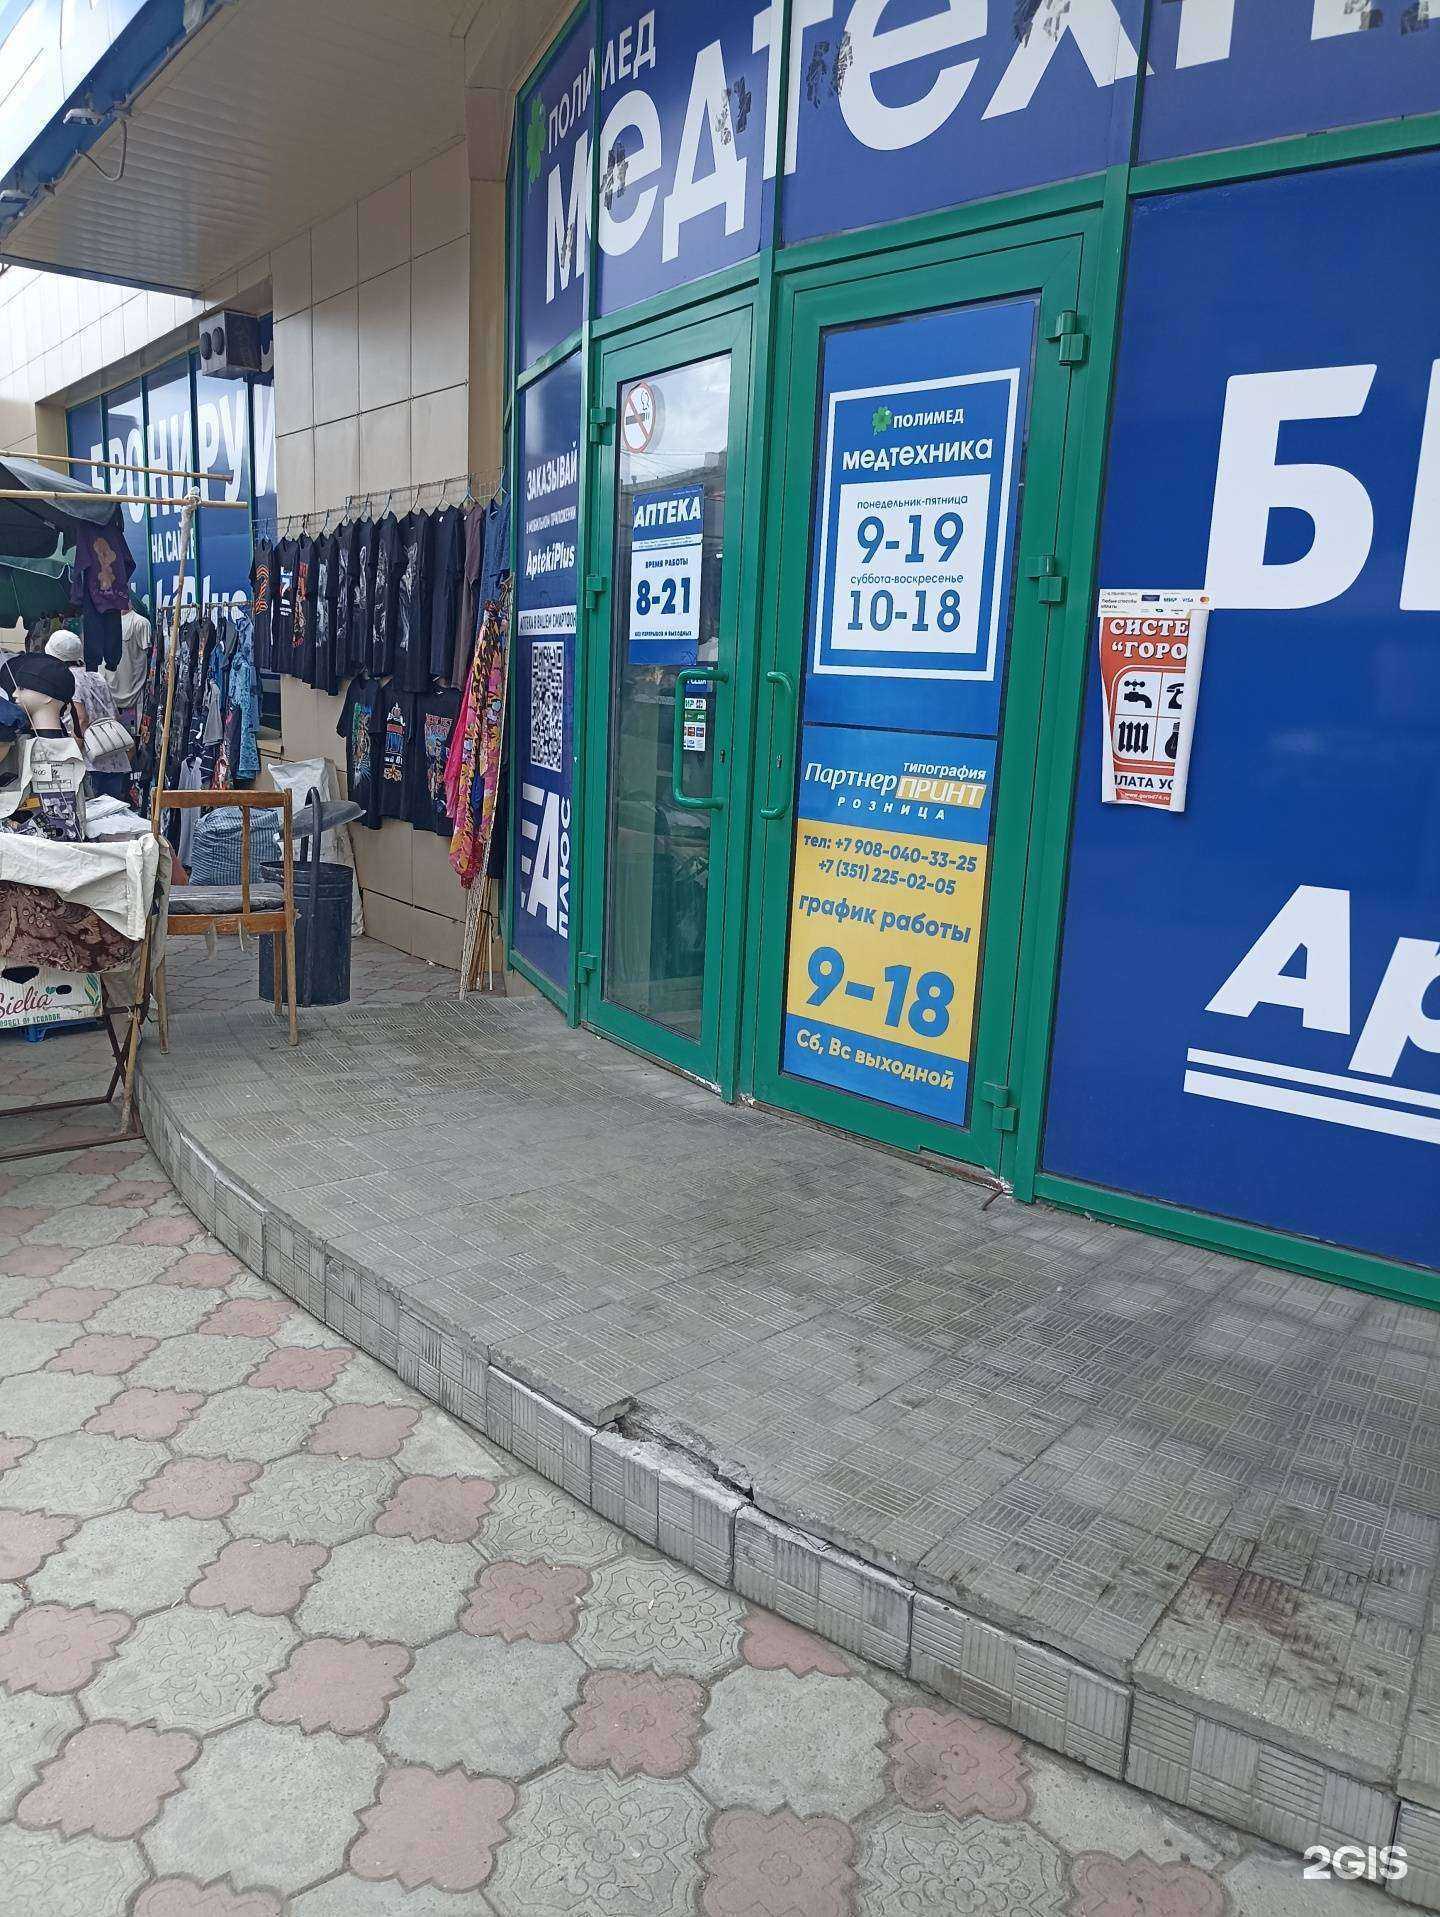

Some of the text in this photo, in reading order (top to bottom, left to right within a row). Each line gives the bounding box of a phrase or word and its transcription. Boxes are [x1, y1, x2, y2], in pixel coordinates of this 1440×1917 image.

[548, 9, 656, 154] ПОЛИМЕД
[892, 408, 965, 429] ПОЛИМЕД
[526, 441, 578, 501] ЗАКАЗЫВАЙ
[842, 437, 993, 471] медтехника
[857, 494, 968, 509] понедельник-пятница
[1204, 359, 1440, 611] Б
[633, 497, 702, 529] АПТЕКА
[151, 532, 164, 563] НА
[857, 512, 964, 564] 9-19
[526, 541, 575, 580] AptekiPlus
[665, 558, 688, 567] РАБОТЫ
[850, 573, 964, 586] суббота-воскресенье
[636, 577, 690, 615] 8-21
[848, 589, 960, 632] 10-18
[805, 762, 897, 796] Партнер
[903, 761, 986, 780] типография
[804, 833, 977, 872] тел: +7 908-040-33-25
[818, 860, 956, 896] +7 (351) 225-02-05
[799, 895, 970, 943] график работы
[806, 946, 954, 1037] 9-18
[797, 1029, 953, 1089] Сб, Вс выходной
